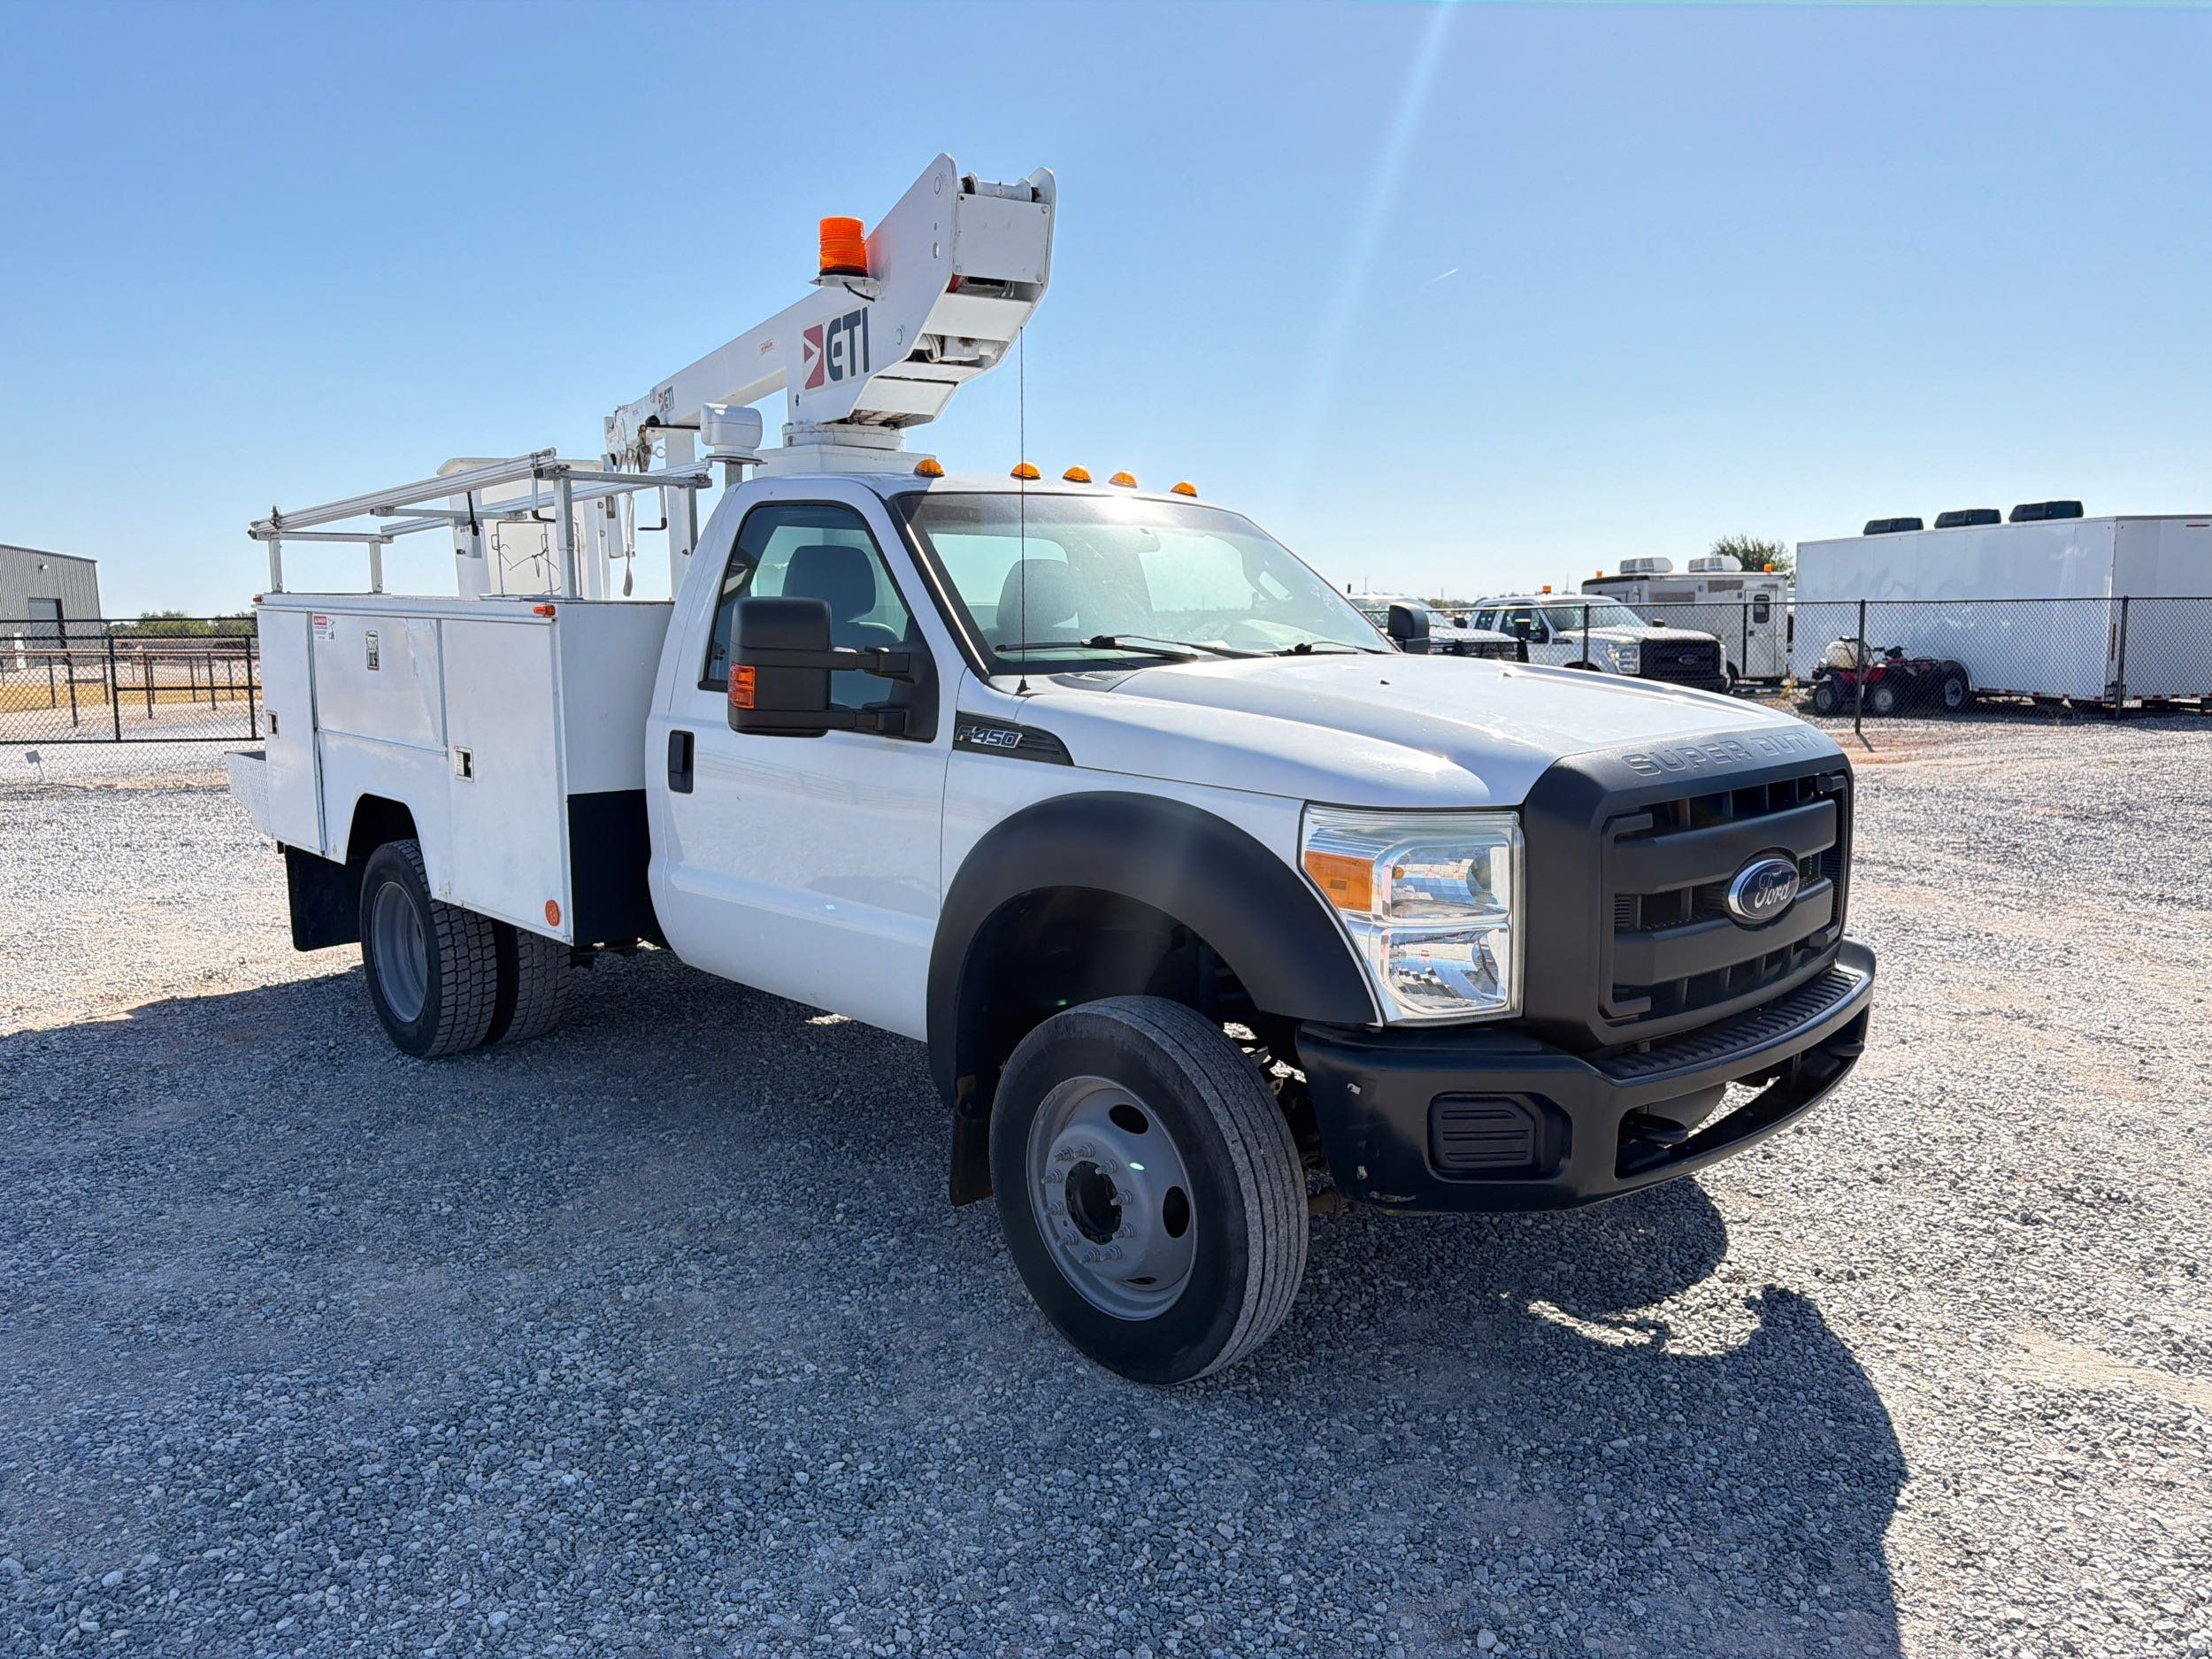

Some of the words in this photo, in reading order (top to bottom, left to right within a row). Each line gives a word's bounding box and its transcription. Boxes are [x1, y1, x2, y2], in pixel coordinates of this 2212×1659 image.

[826, 306, 870, 381] ETI
[664, 386, 675, 410] ETI
[1621, 741, 1753, 777] SUPER
[1749, 730, 1820, 757] DUTY
[1755, 870, 1791, 909] Ford
